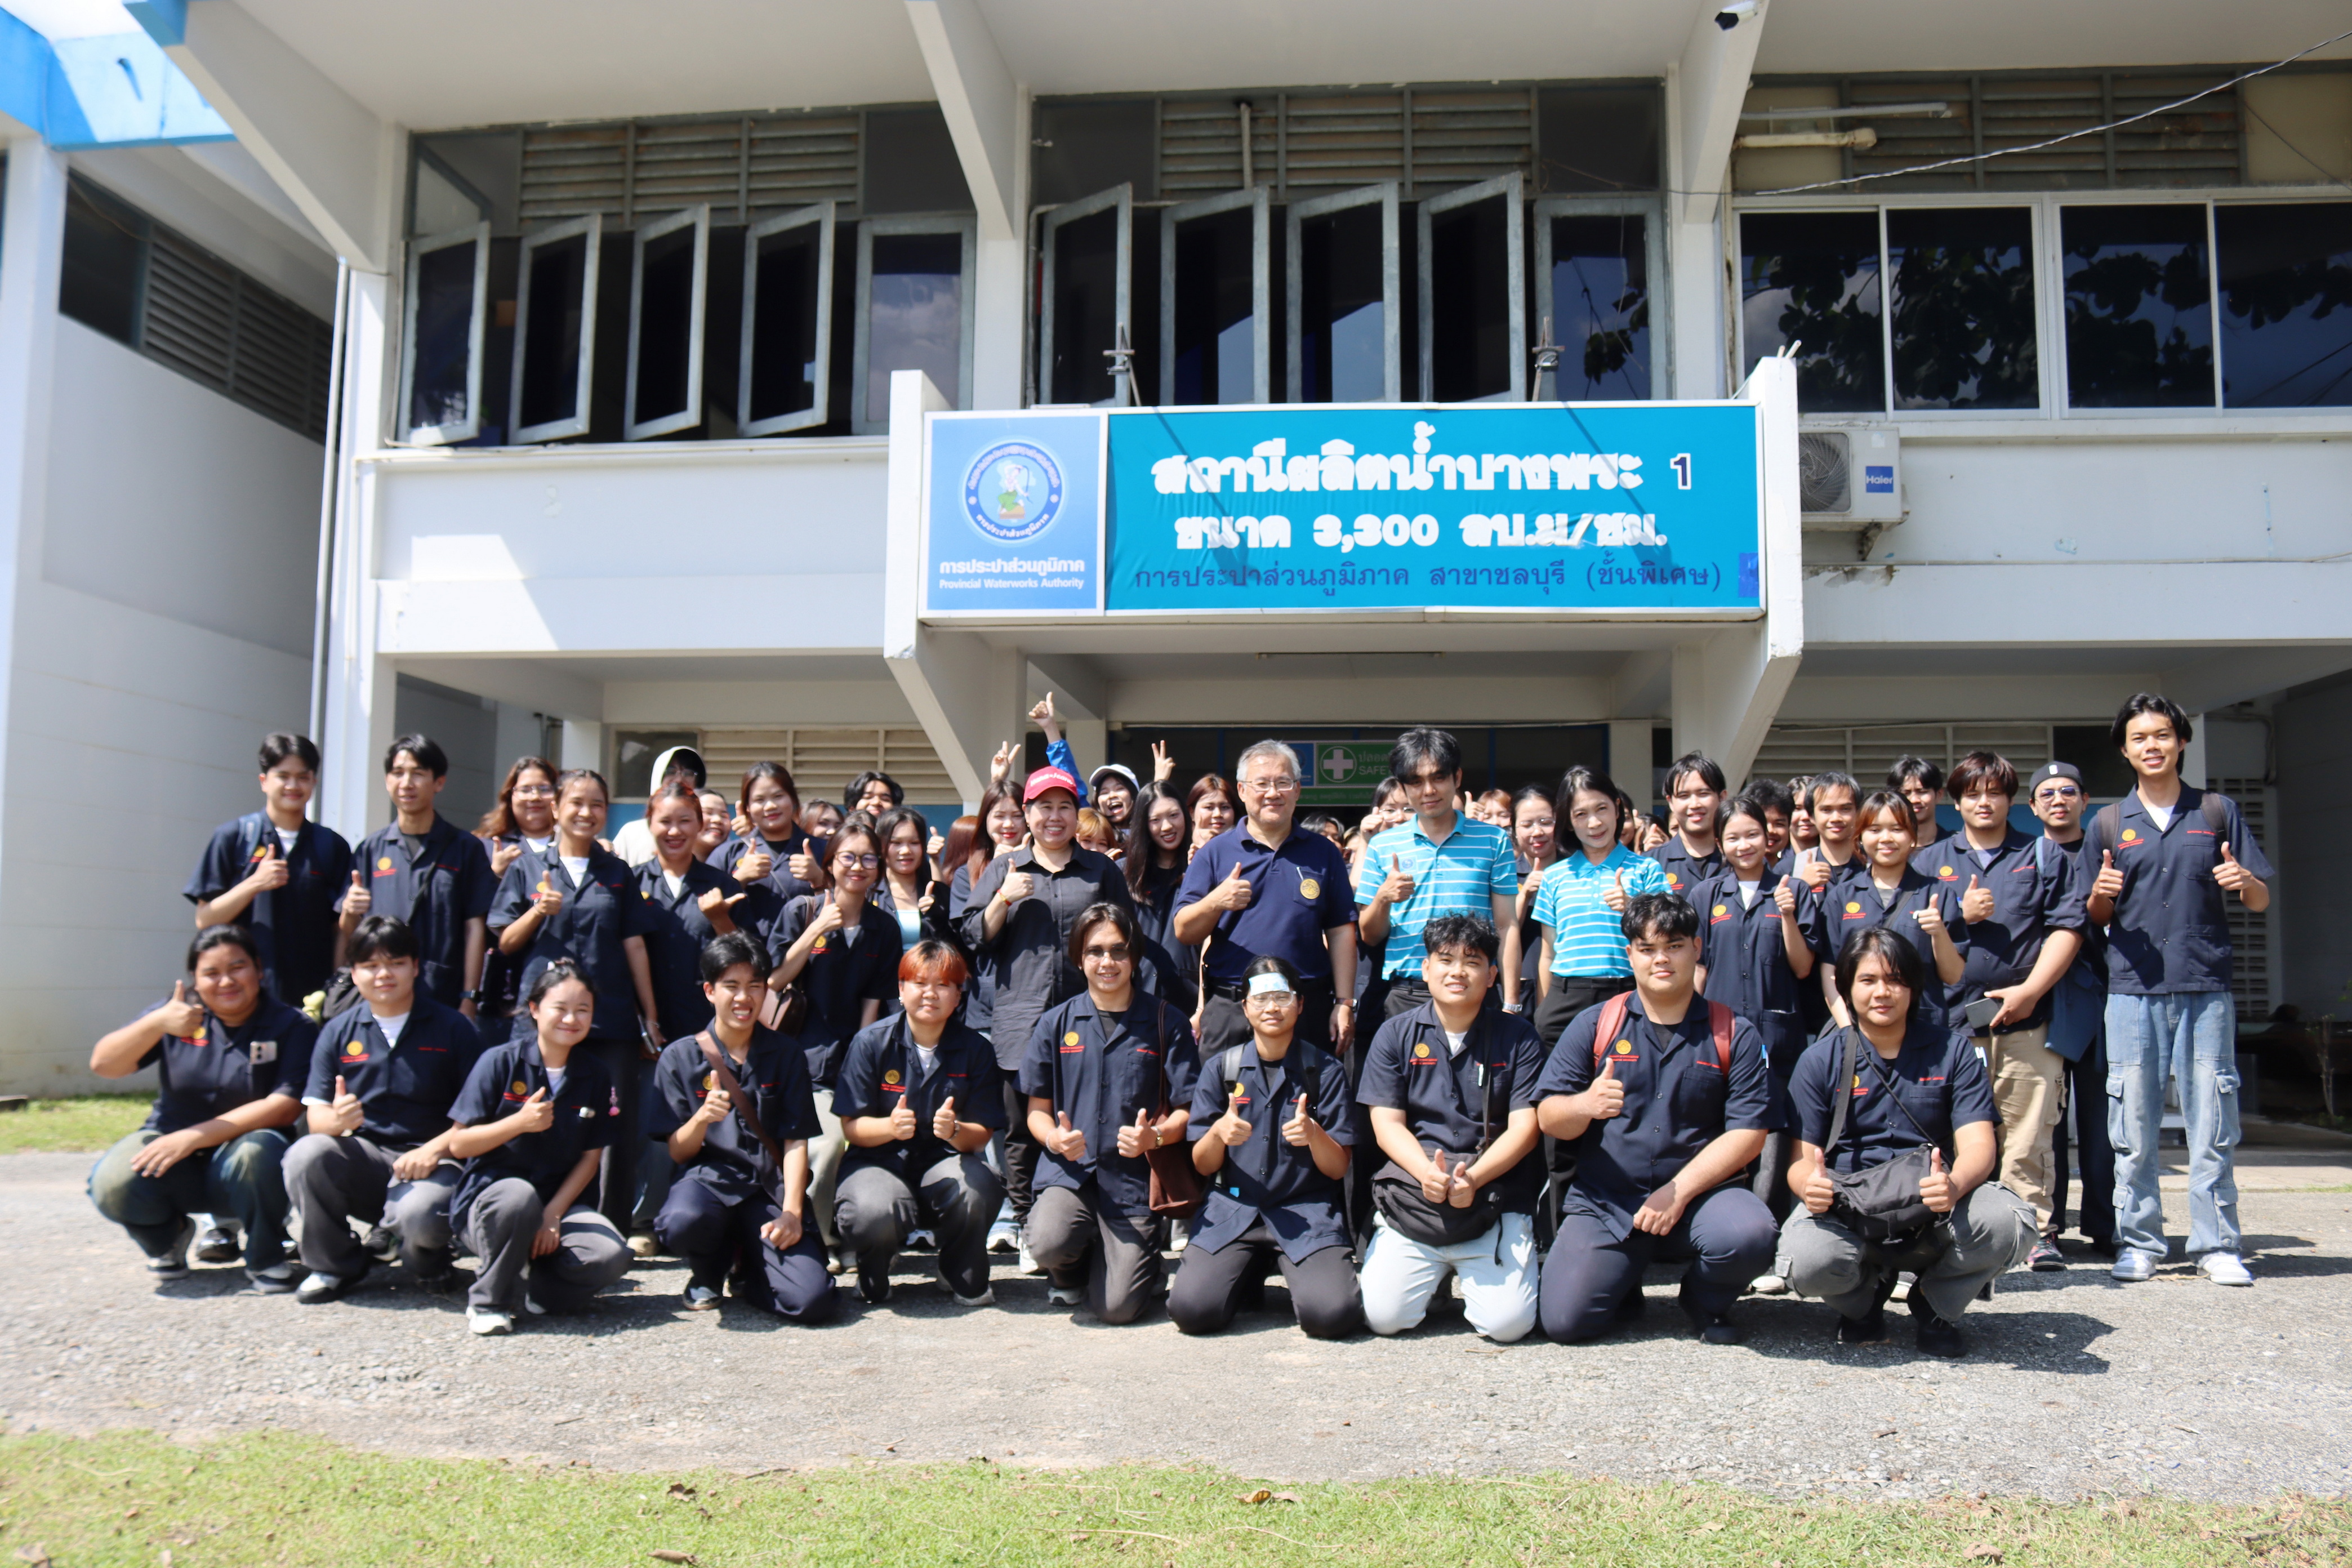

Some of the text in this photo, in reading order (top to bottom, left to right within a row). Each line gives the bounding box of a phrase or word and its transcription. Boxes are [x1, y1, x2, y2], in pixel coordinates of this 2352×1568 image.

[1151, 421, 1690, 495] สถานีผลิตน้ำบางพระ 1
[1866, 475, 1892, 484] Haier
[1174, 515, 1291, 550] ขนาด
[1313, 514, 1440, 553] 3,300
[939, 557, 1085, 576] การประปาส่วนภูมิภาค
[1135, 550, 1721, 596] การประปาส่วนภูมิภาค สาขาชลบุรี (ชั้นพิเศษ)
[939, 577, 1084, 590] Provincial Waterworks Authority
